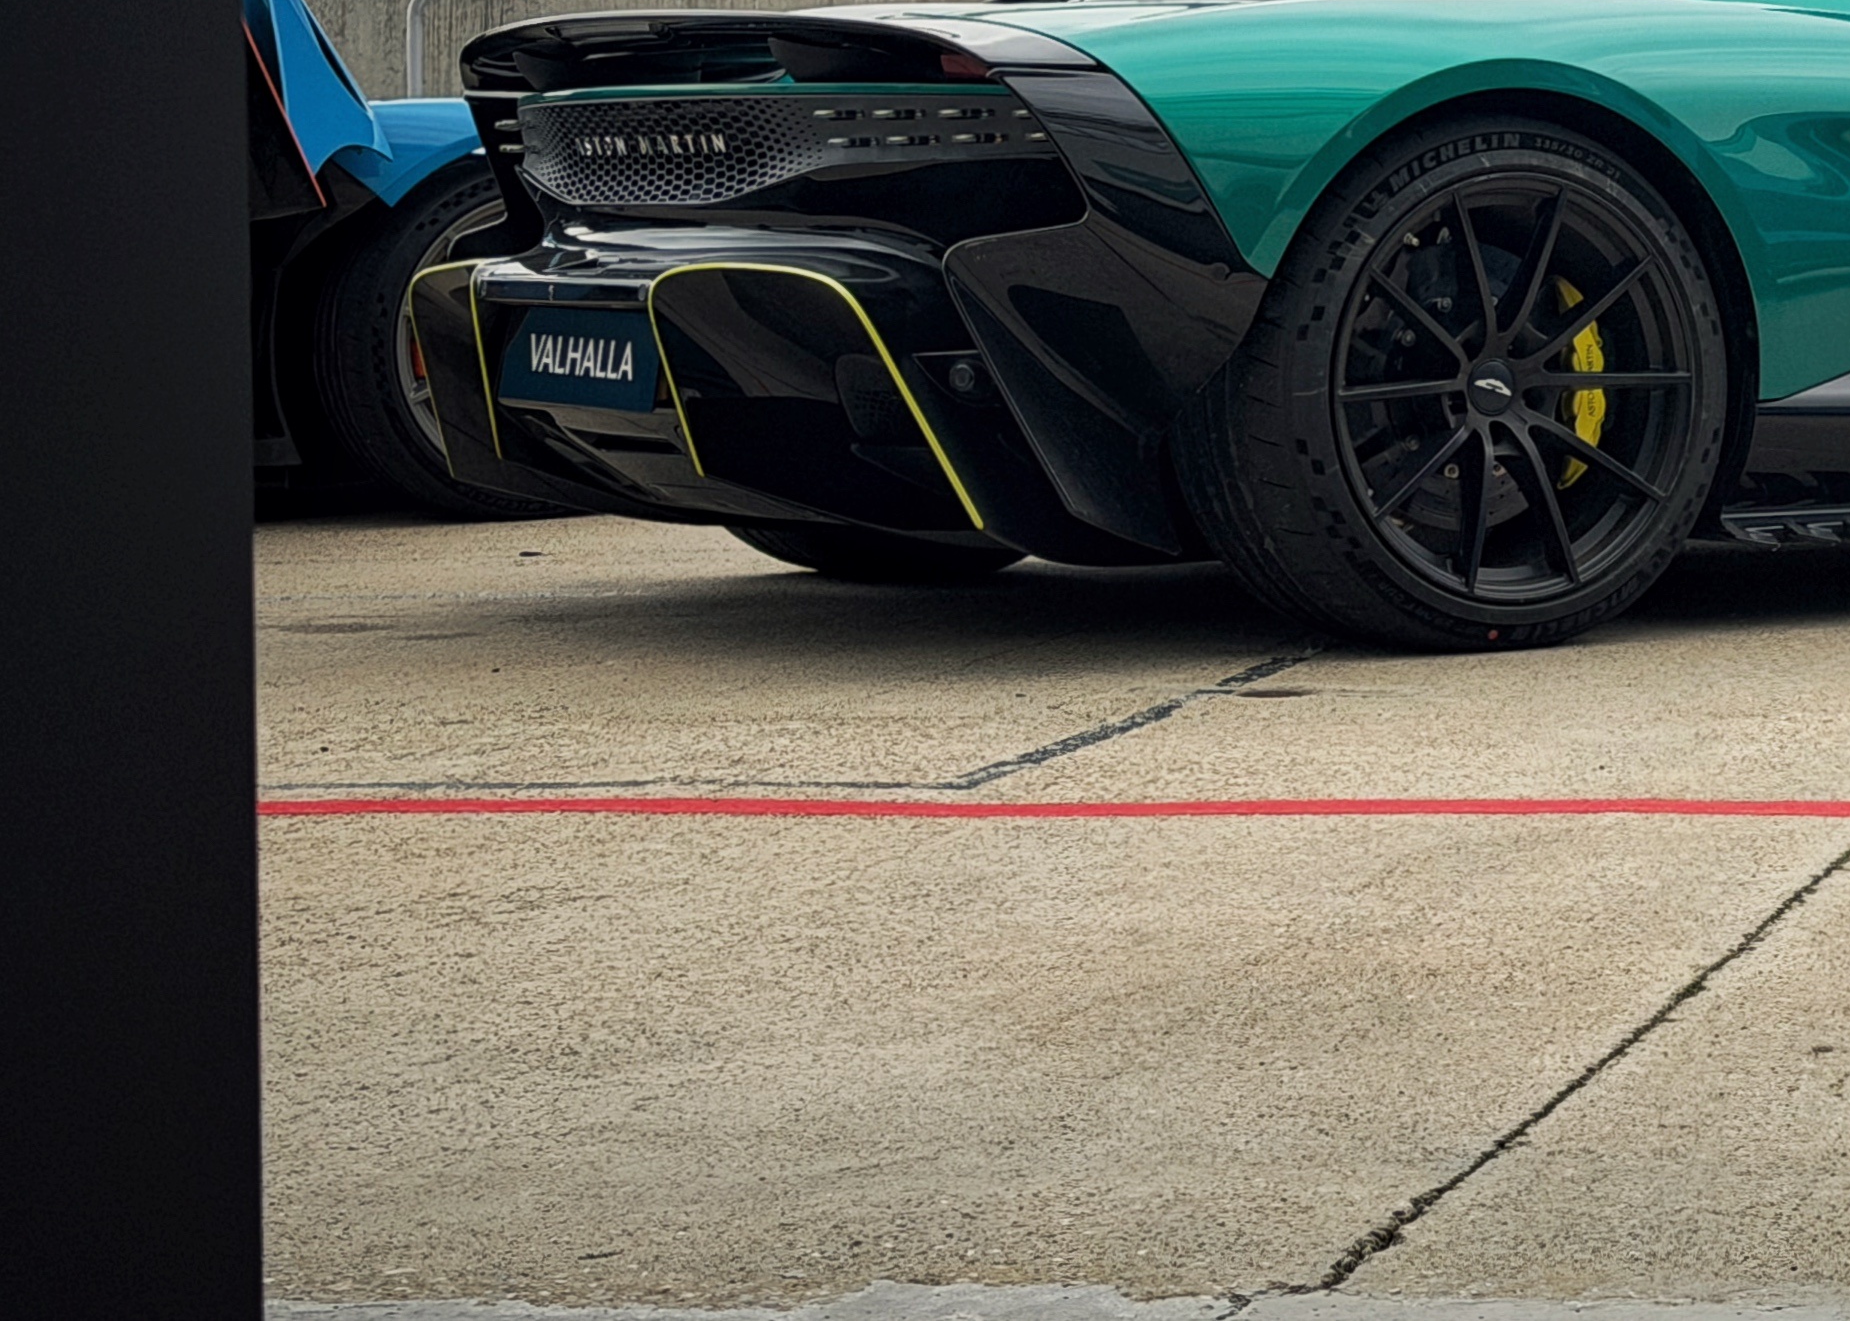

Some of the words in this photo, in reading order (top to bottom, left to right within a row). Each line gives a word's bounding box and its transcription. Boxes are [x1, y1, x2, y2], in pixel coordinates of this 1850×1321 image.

[1390, 131, 1522, 194] MICHELIN
[530, 332, 633, 381] VALHALLA
[1587, 392, 1597, 418] ASTO
